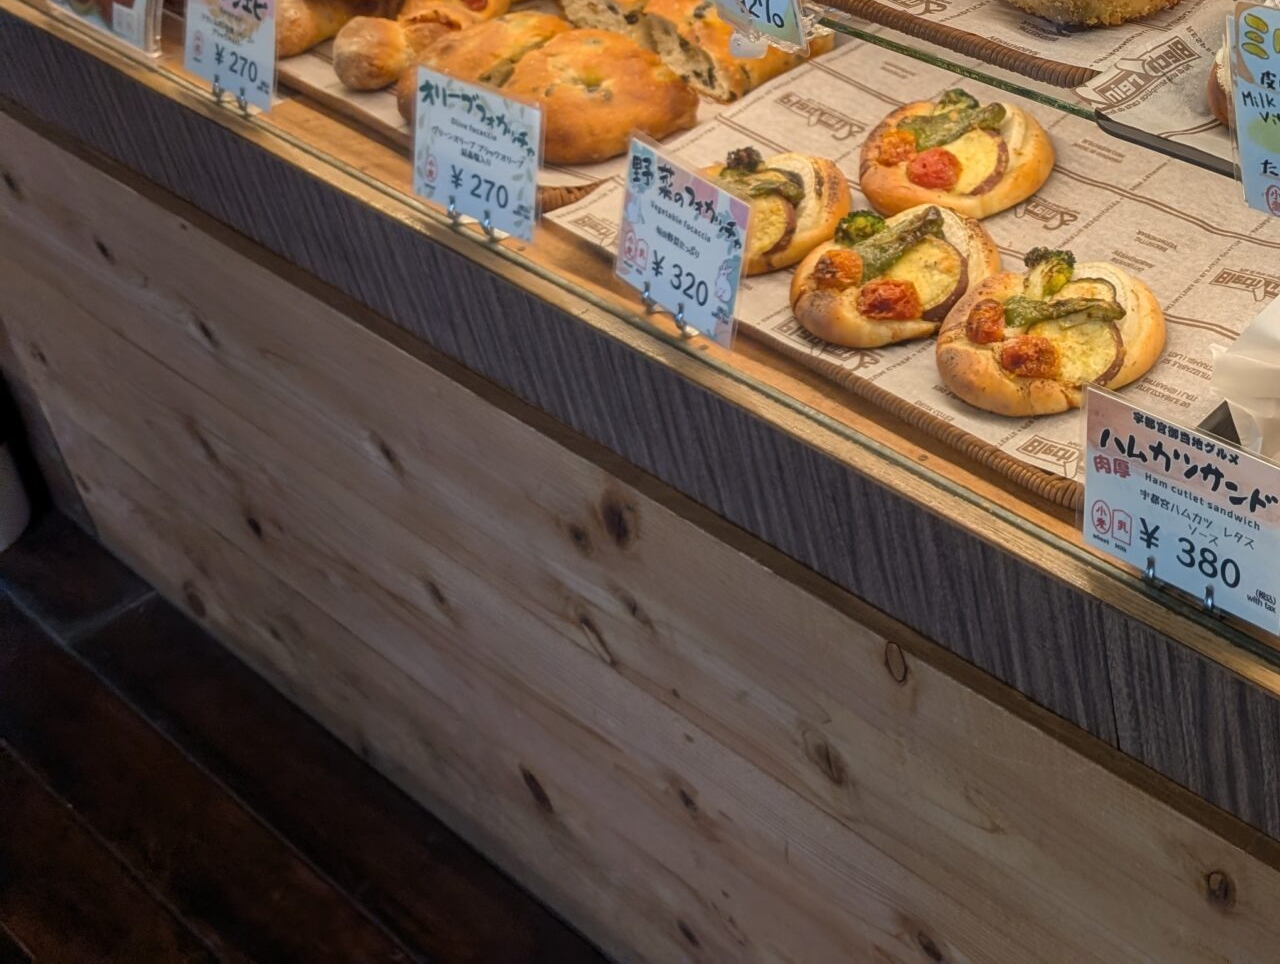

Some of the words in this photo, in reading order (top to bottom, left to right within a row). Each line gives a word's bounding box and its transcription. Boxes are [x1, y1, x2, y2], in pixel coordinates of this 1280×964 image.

[214, 43, 259, 84] ¥270
[450, 117, 468, 130] Olive
[1241, 91, 1276, 109] Milk
[450, 164, 509, 210] ¥270
[632, 154, 742, 251] 野菜のフォカッチャ
[652, 249, 709, 307] ¥320
[1132, 411, 1240, 467] 宇都宮御当地グルメ
[1093, 454, 1131, 479] 肉厚
[1100, 428, 1279, 513] ハムカツサンド
[1139, 488, 1212, 529] 宇都宮ハムカツ
[1223, 527, 1255, 551] レタス
[1144, 472, 1168, 490] Ham
[1171, 485, 1205, 506] cutlet
[1207, 500, 1261, 532] sandwich
[1139, 517, 1241, 588] ¥380
[1187, 523, 1219, 547] ソース
[1246, 593, 1264, 608] with
[1263, 601, 1277, 614] tax
